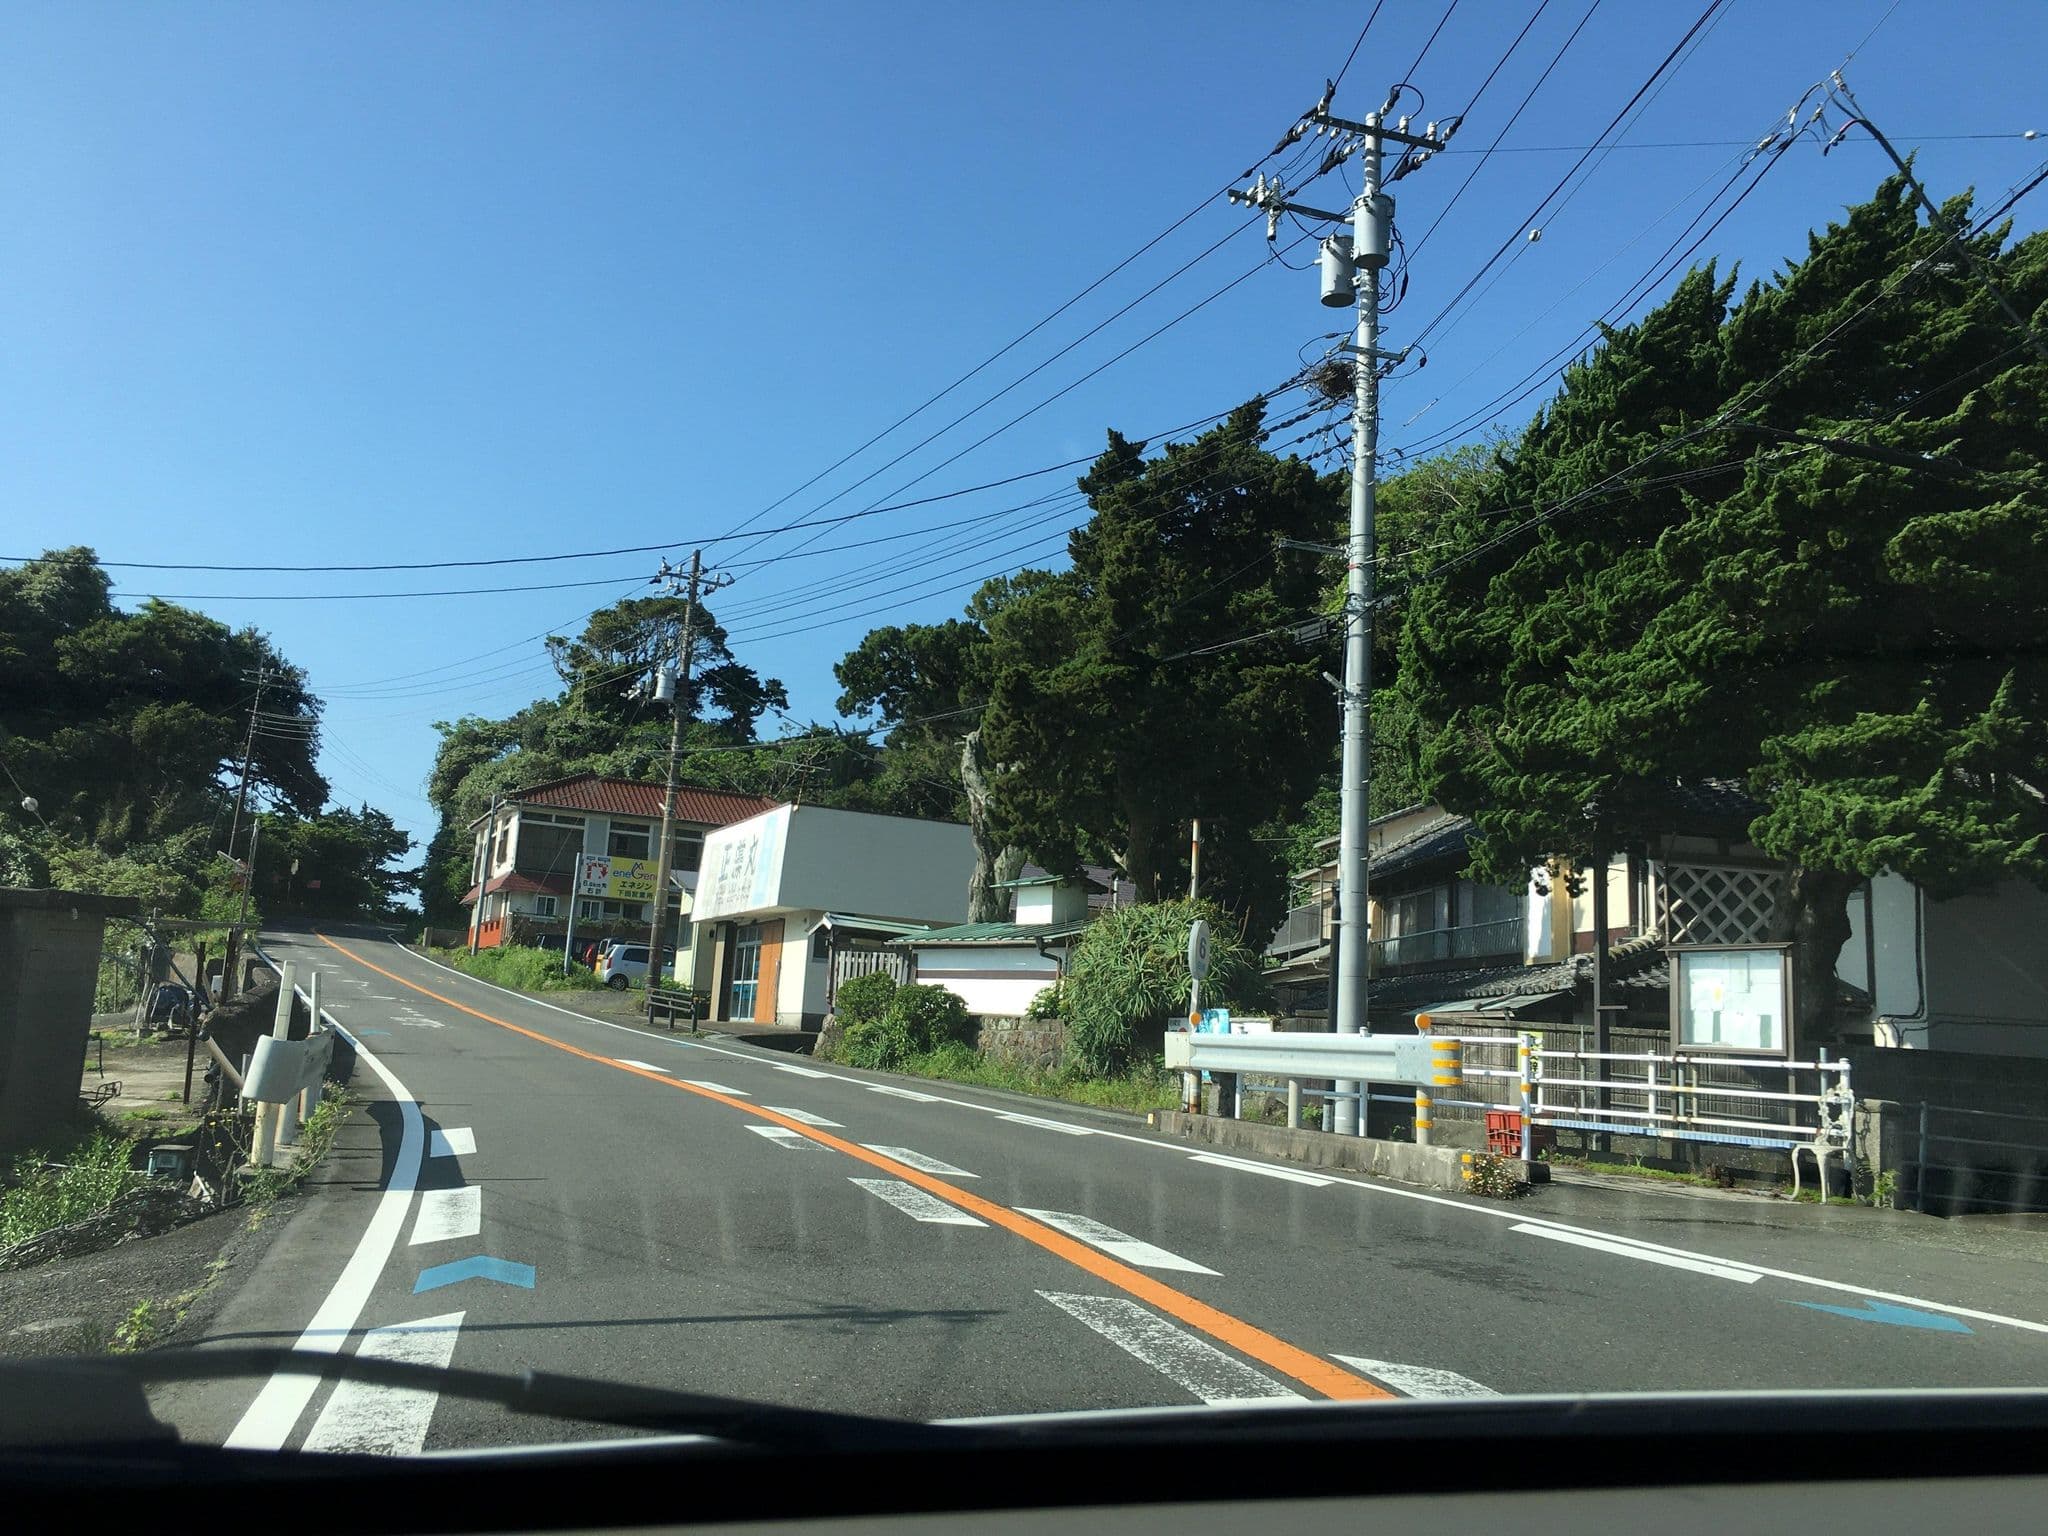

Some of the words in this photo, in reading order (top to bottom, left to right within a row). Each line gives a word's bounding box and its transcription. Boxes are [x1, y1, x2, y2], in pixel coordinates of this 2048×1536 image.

[620, 880, 653, 891] エネジン
[1199, 936, 1207, 960] 6
